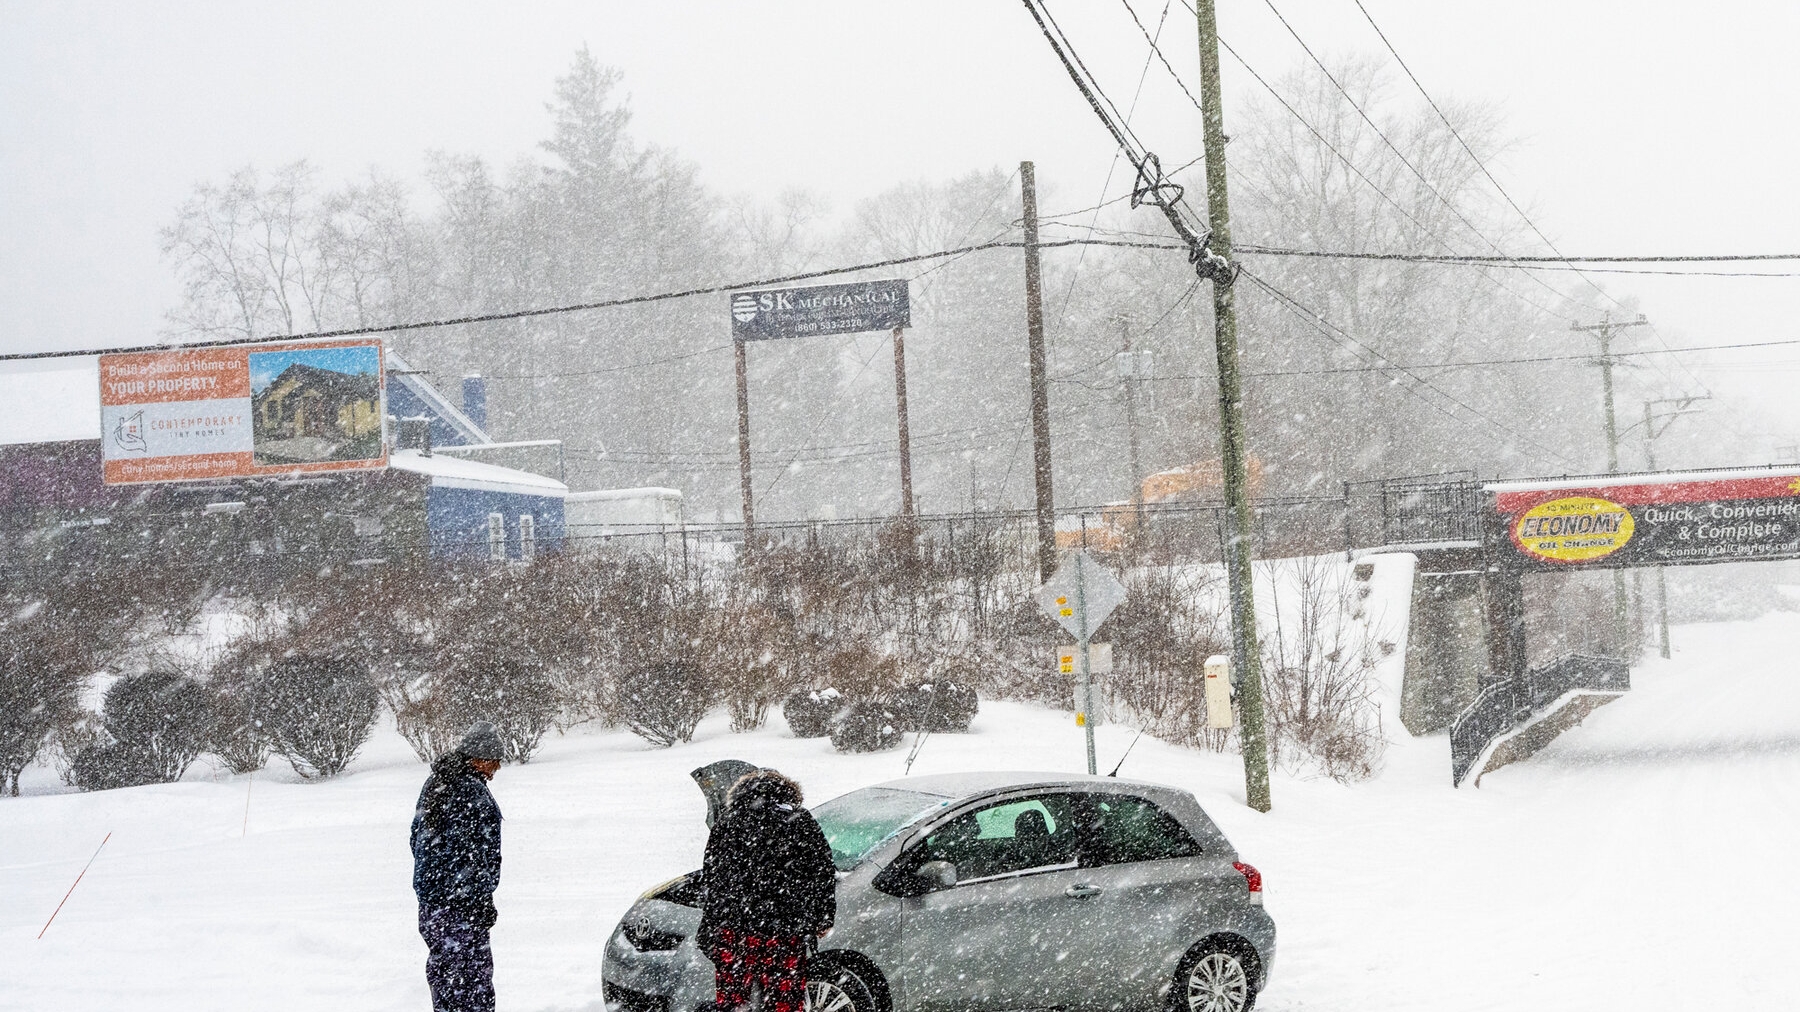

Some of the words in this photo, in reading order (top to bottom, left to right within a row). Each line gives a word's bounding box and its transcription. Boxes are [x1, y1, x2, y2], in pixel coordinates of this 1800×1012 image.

[760, 293, 794, 312] SK
[799, 291, 900, 309] MECHANICAL
[109, 365, 137, 377] Build
[149, 361, 190, 375] Second
[193, 360, 225, 371] Home
[227, 359, 241, 369] on
[108, 381, 145, 394] YOUR
[152, 416, 241, 430] CONTEMPORARY
[195, 429, 225, 437] HOMES
[1522, 512, 1625, 538] ECONOMY
[1679, 526, 1691, 540] &
[1698, 522, 1782, 540] Complete
[1539, 541, 1558, 549] OIL
[1563, 538, 1615, 549] CHANGE
